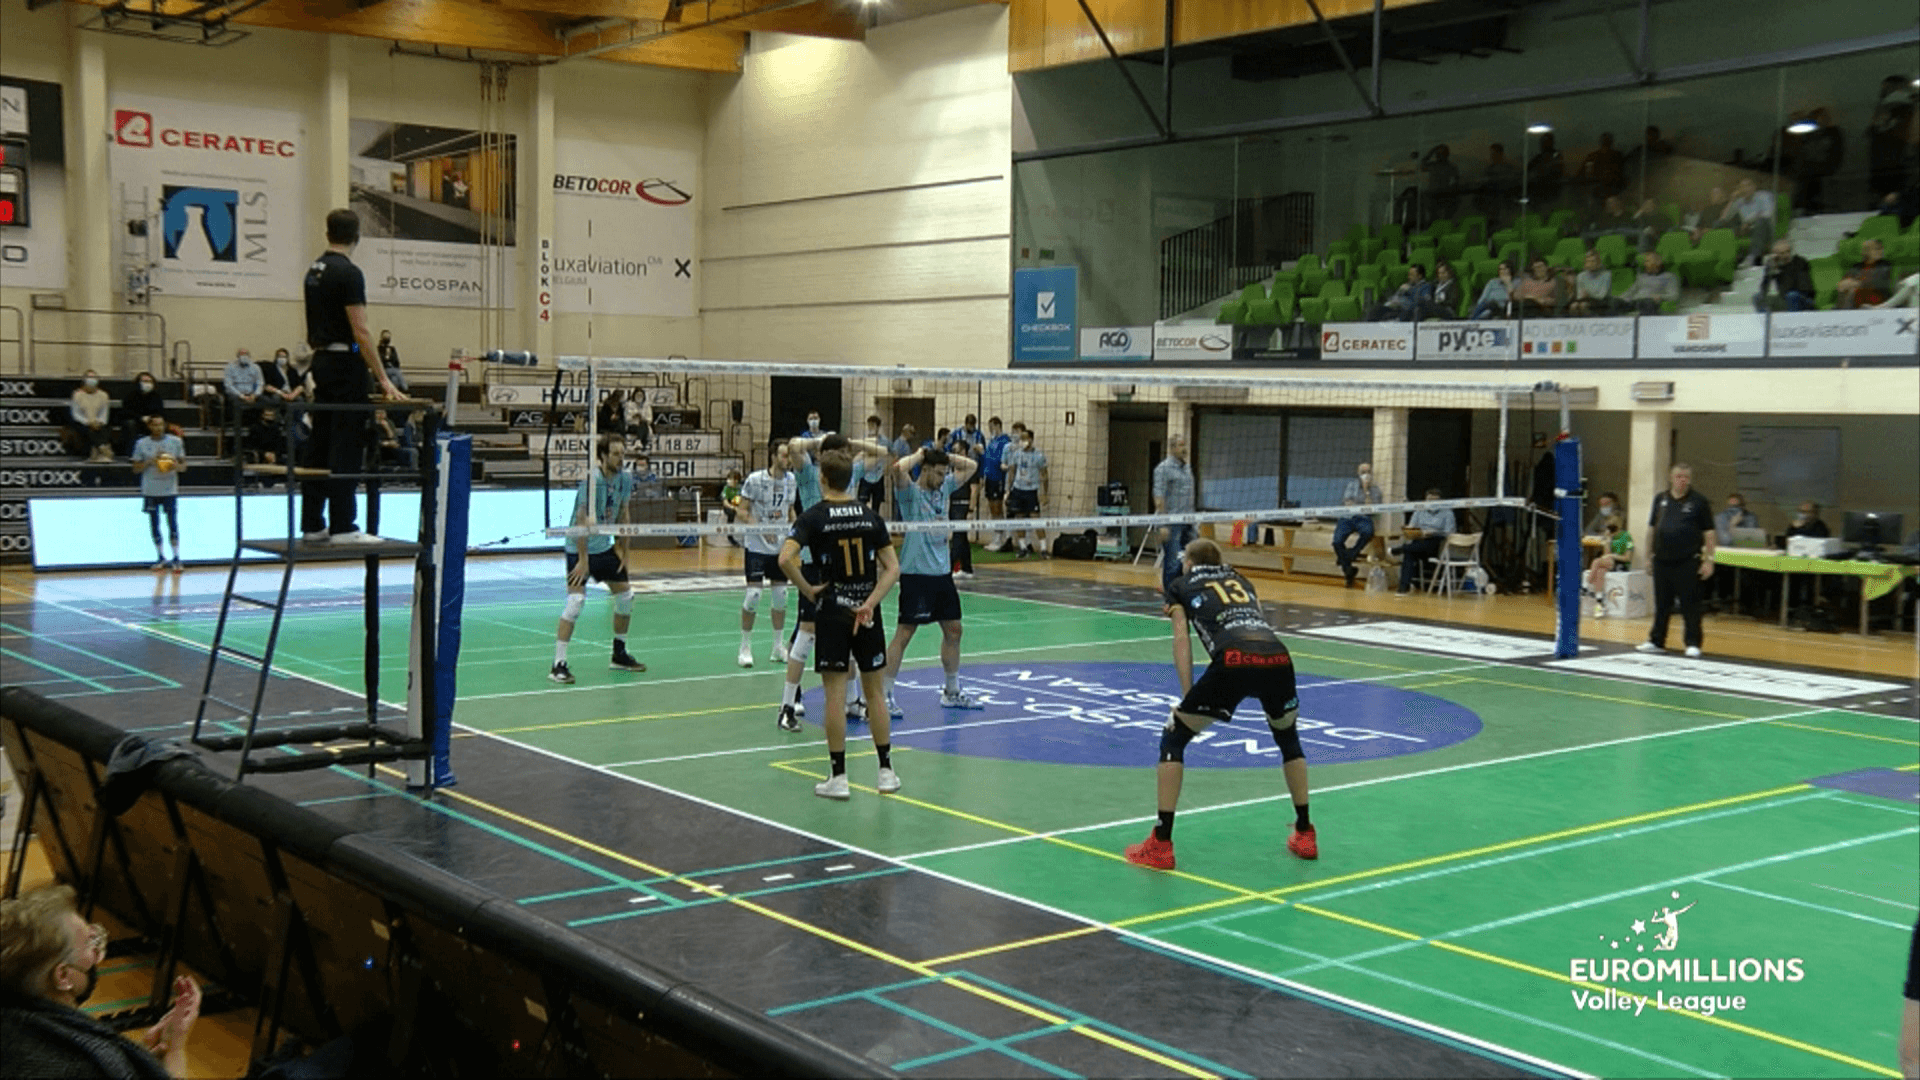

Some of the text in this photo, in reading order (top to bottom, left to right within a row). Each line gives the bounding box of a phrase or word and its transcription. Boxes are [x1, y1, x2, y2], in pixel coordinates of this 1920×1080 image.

[160, 128, 296, 158] CERATEC
[553, 174, 632, 196] BETOCOR
[243, 191, 268, 263] MLS
[381, 275, 484, 293] DECOSPAN
[1156, 338, 1198, 347] BETOCOR
[1341, 338, 1407, 351] CERATEC
[1438, 327, 1497, 352] pype
[772, 493, 784, 507] 17
[829, 506, 864, 518] AKSELI
[822, 521, 873, 533] DECOSPAN
[838, 537, 865, 577] 11
[1204, 579, 1250, 605] 13
